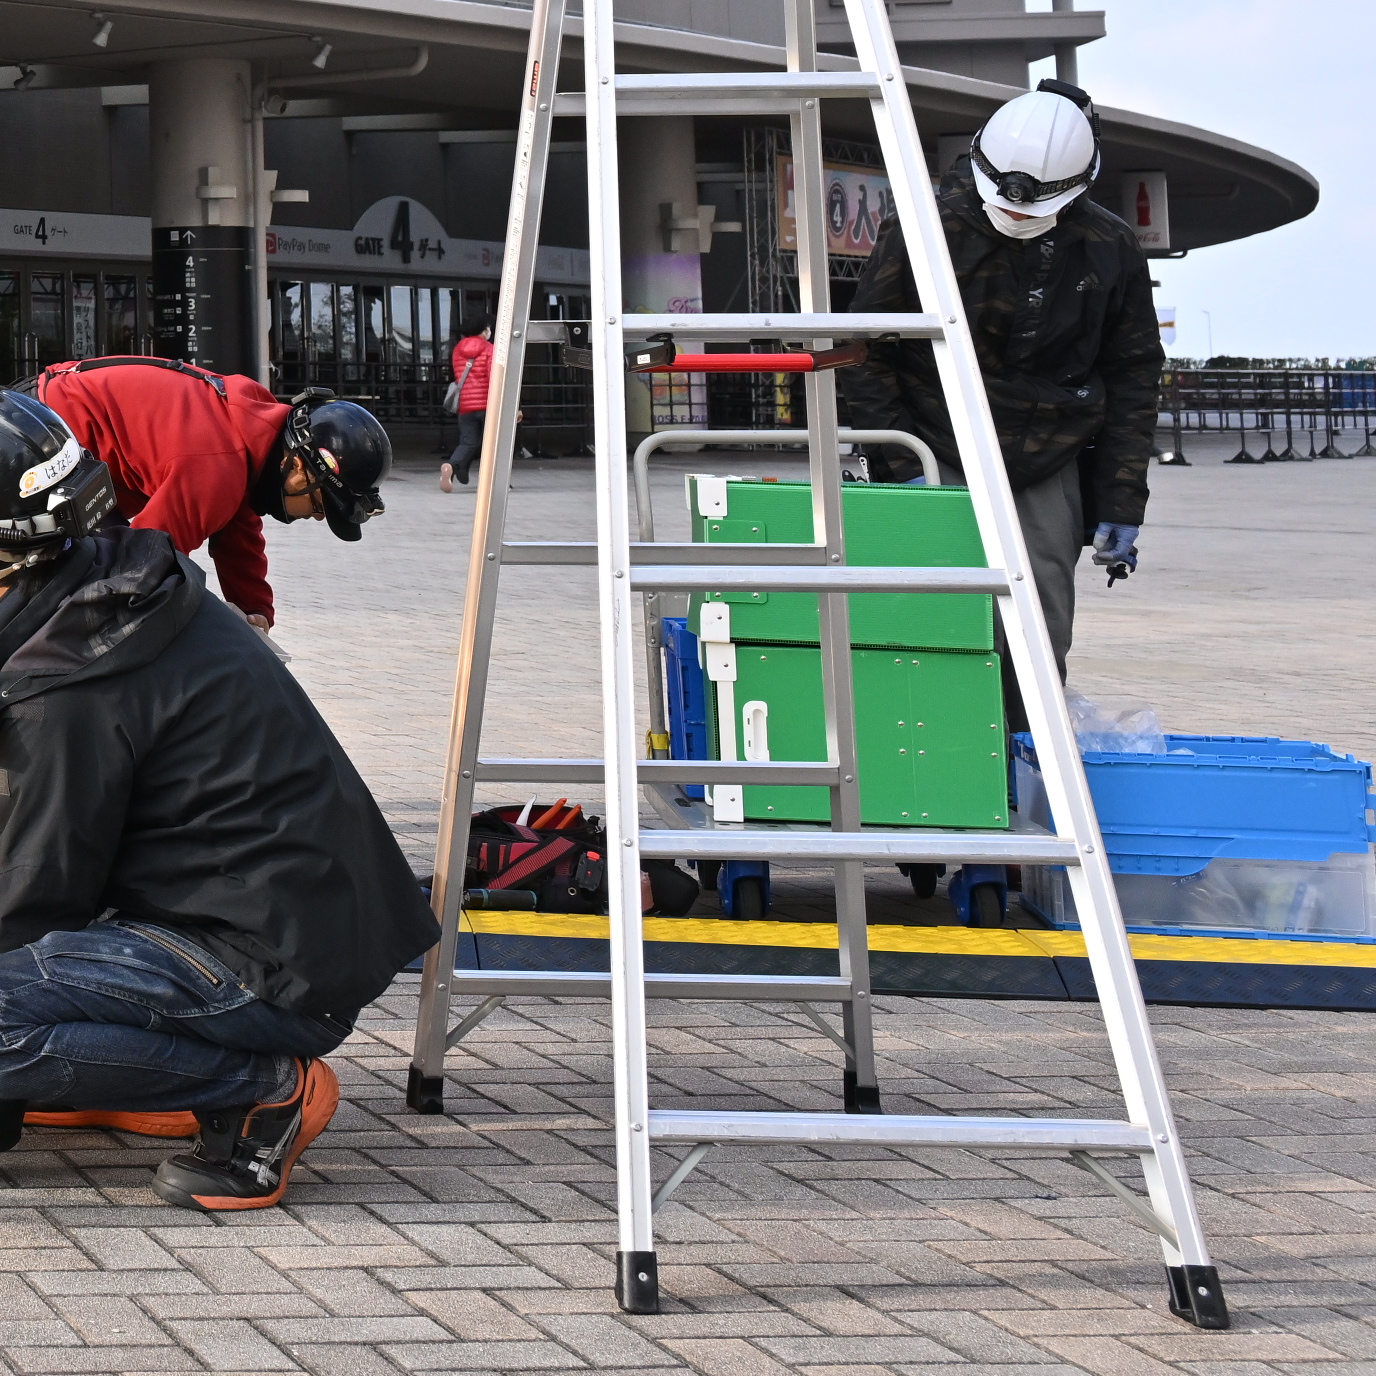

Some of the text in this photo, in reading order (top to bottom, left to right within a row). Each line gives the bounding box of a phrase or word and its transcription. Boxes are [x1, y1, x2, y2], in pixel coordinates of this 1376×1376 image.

[832, 202, 844, 227] 4
[13, 224, 33, 236] GATE
[34, 216, 48, 245] 4
[50, 226, 68, 236] ゲート
[354, 236, 384, 256] GATE
[390, 200, 414, 264] 4
[418, 238, 446, 260] ゲート
[277, 236, 331, 254] PayPay Dome
[185, 256, 194, 267] 4
[187, 298, 196, 310] 3
[188, 325, 197, 337] 2
[84, 485, 107, 512] GENTOS
